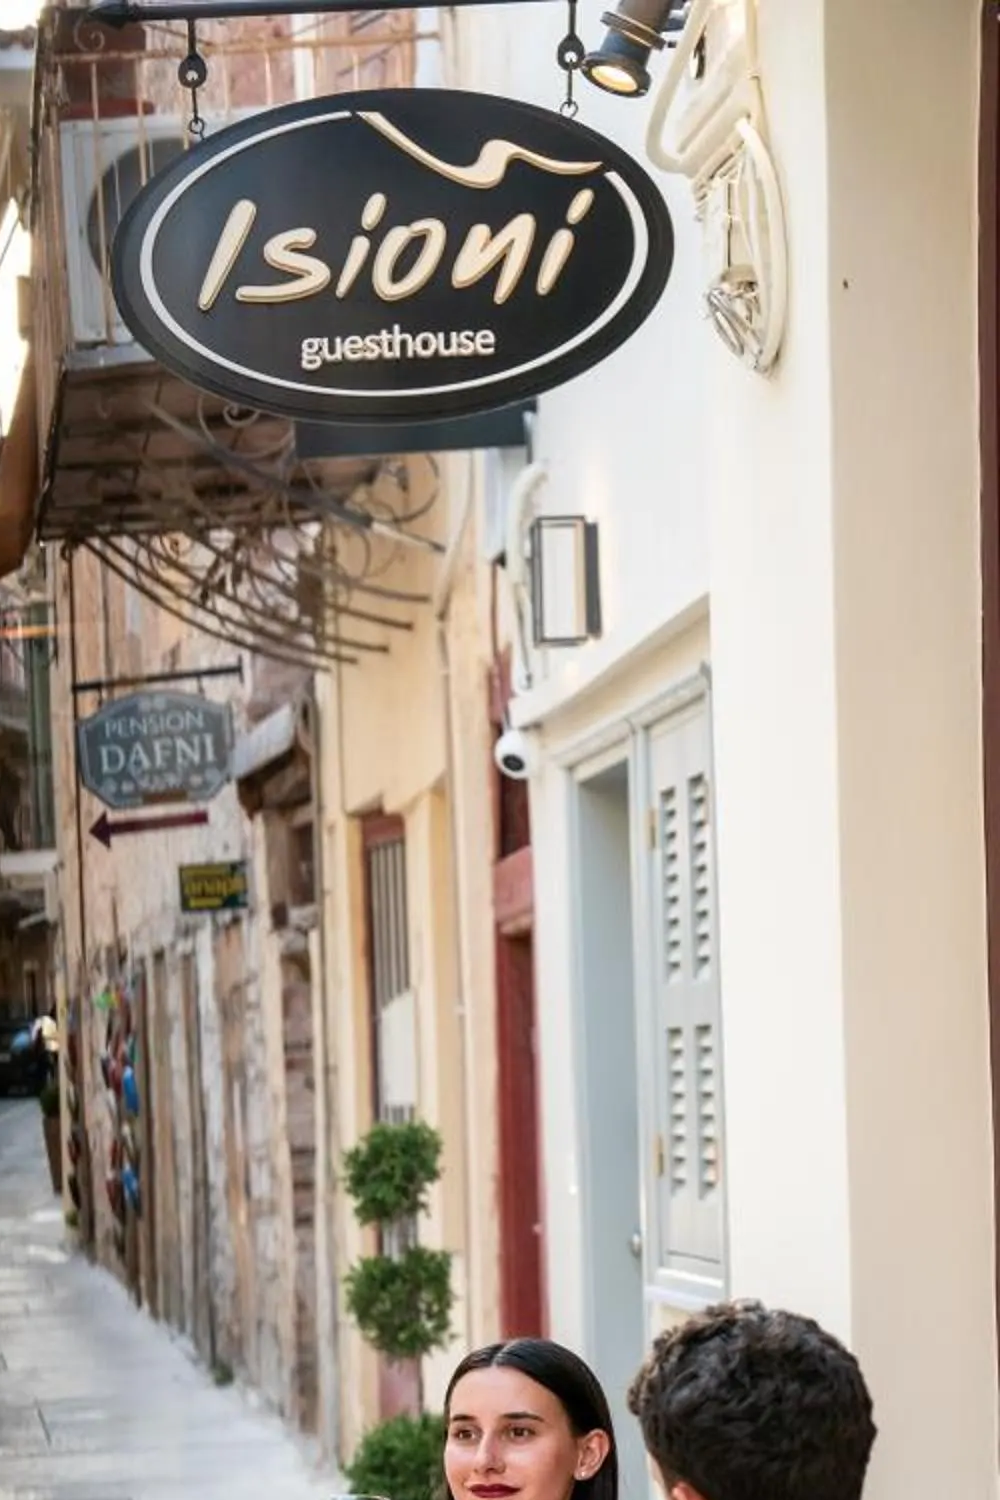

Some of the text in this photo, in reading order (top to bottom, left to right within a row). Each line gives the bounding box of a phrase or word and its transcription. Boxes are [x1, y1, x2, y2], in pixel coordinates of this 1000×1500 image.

[198, 187, 594, 311] Isioni
[300, 324, 496, 370] guesthouse
[104, 710, 204, 738] PENSION
[99, 732, 217, 774] DAFNI
